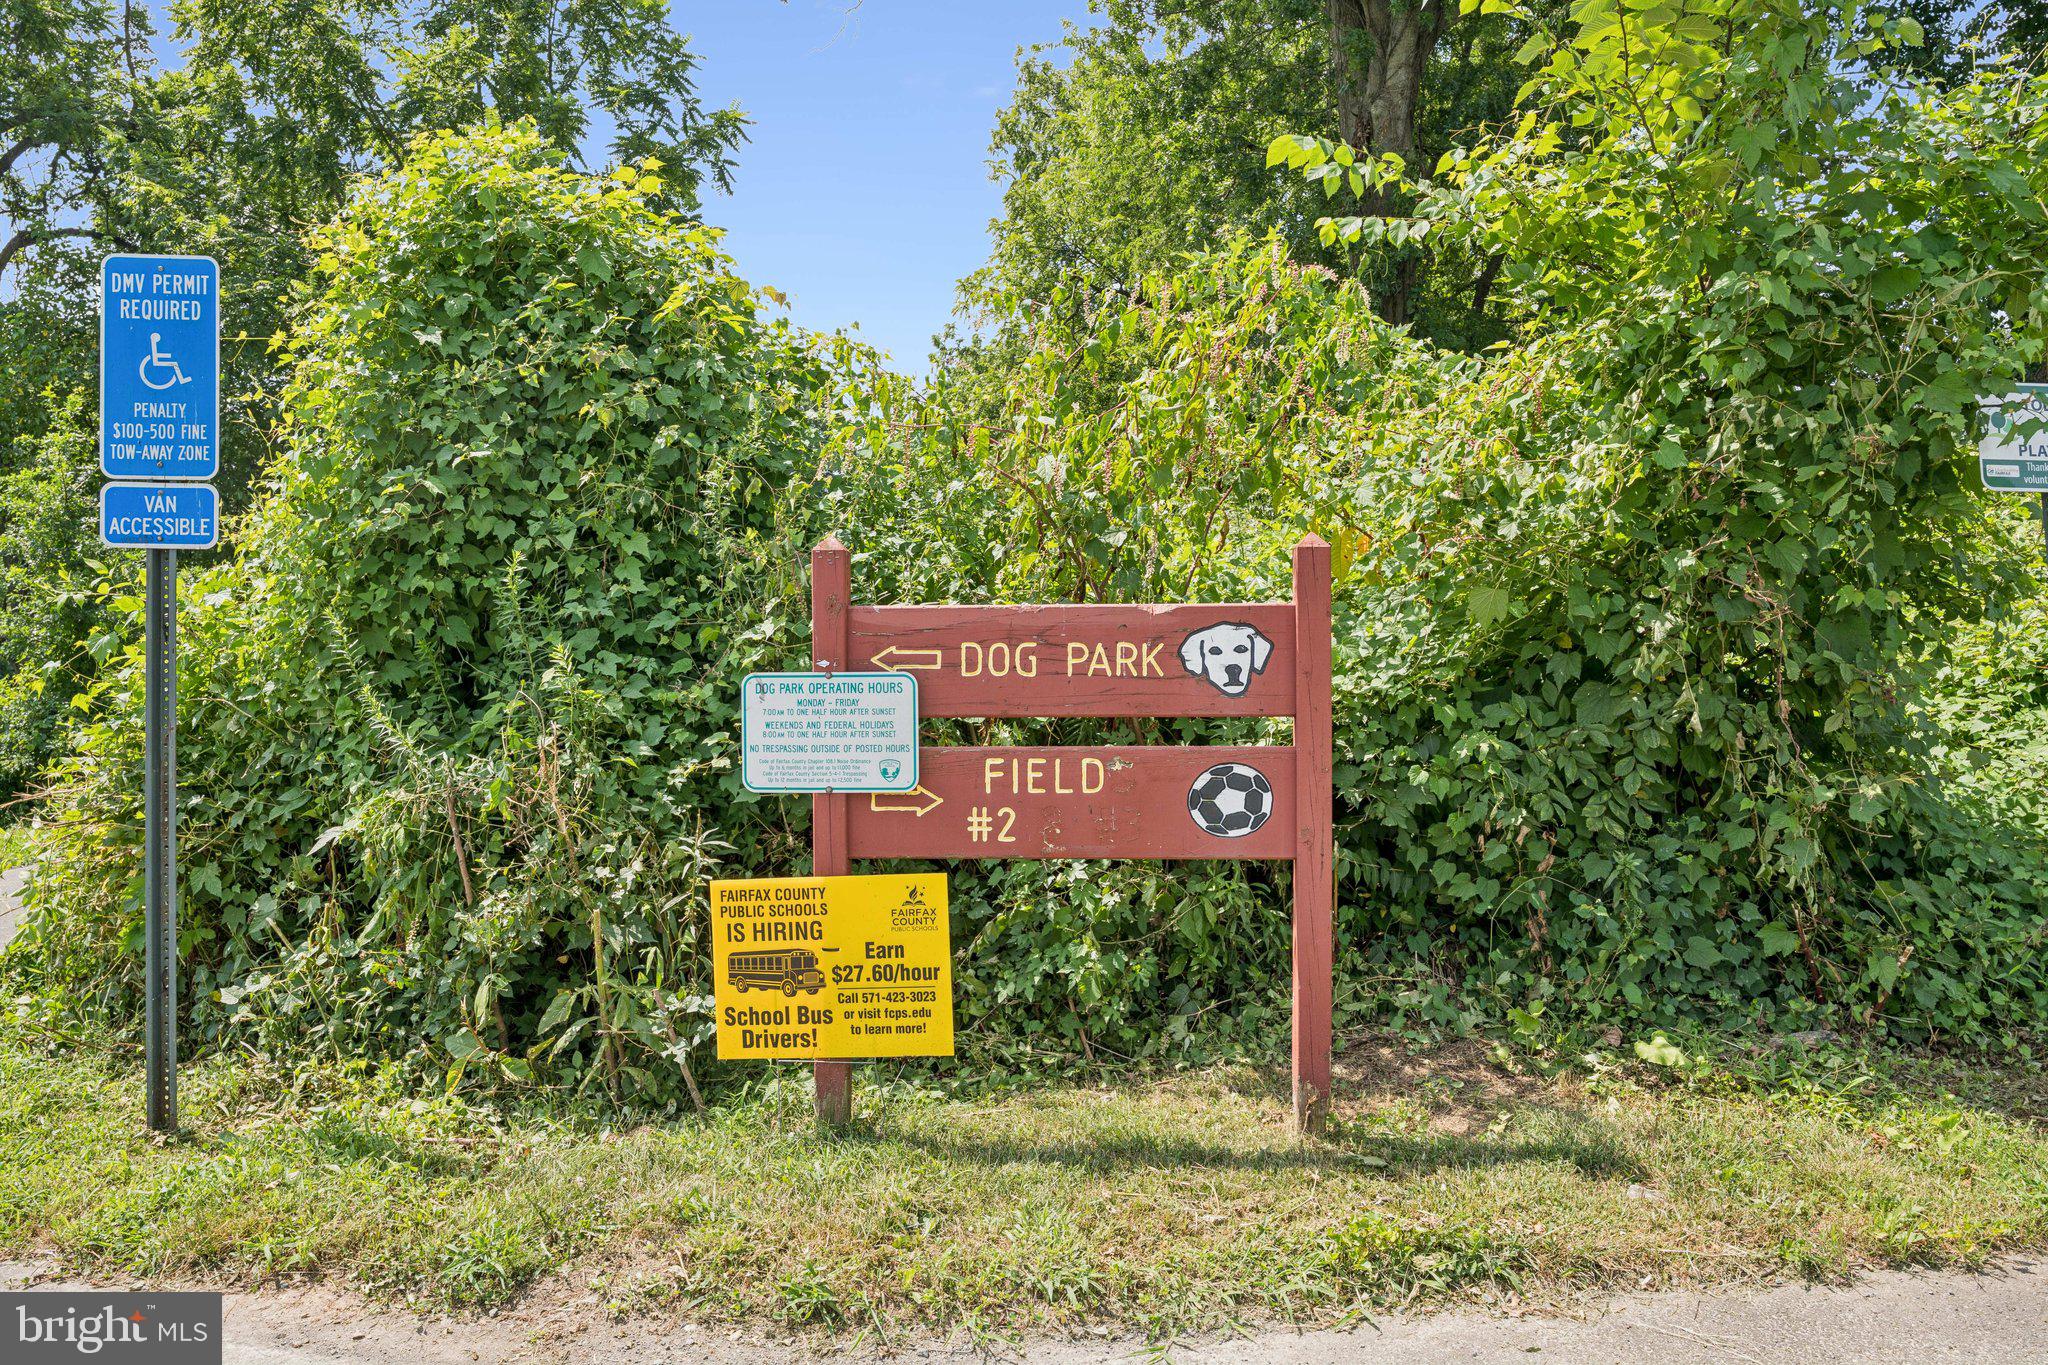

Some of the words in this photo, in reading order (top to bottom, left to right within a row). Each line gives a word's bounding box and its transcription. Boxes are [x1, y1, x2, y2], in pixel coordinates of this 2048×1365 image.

[112, 273, 145, 293] DMV
[152, 274, 209, 295] PERMIT
[120, 299, 200, 321] REQUIRED
[134, 403, 186, 418] PENALTY
[113, 423, 174, 439] $100-500
[182, 425, 207, 440] FINE
[111, 444, 174, 461] TOW-AWAY
[178, 445, 210, 461] ZONE
[2018, 445, 2048, 456] PLA
[144, 496, 177, 513] VAN
[109, 517, 210, 536] ACCESSIBLE
[961, 642, 1037, 677] DOG
[1067, 642, 1163, 677] PARK
[756, 683, 775, 694] DOG
[780, 683, 804, 694] PARK
[809, 682, 863, 694] OPERATING
[869, 682, 903, 694] HOURS
[985, 758, 1105, 794] FIELD
[967, 806, 1016, 842] #2
[720, 889, 771, 902] FAIRFAX
[775, 887, 826, 900] COUNTY
[720, 905, 765, 918] PUBLIC
[769, 903, 827, 916] SCHOOLS
[891, 908, 936, 917] FAIRFAX
[892, 916, 936, 926] COUNTY
[727, 923, 745, 942] IS
[753, 921, 823, 941] HIRING
[865, 942, 904, 959] Earn
[832, 964, 940, 984] $27.60/hour
[838, 992, 859, 1004] Call
[862, 991, 936, 1004] 571-423-3023
[725, 1006, 790, 1026] School
[798, 1006, 833, 1024] Bus
[844, 1010, 854, 1019] or
[858, 1007, 880, 1019] visit
[884, 1007, 931, 1021] fcps.edu
[851, 1025, 860, 1035] to
[865, 1023, 892, 1034] learn
[896, 1023, 926, 1034] more!
[742, 1029, 818, 1048] Drivers!
